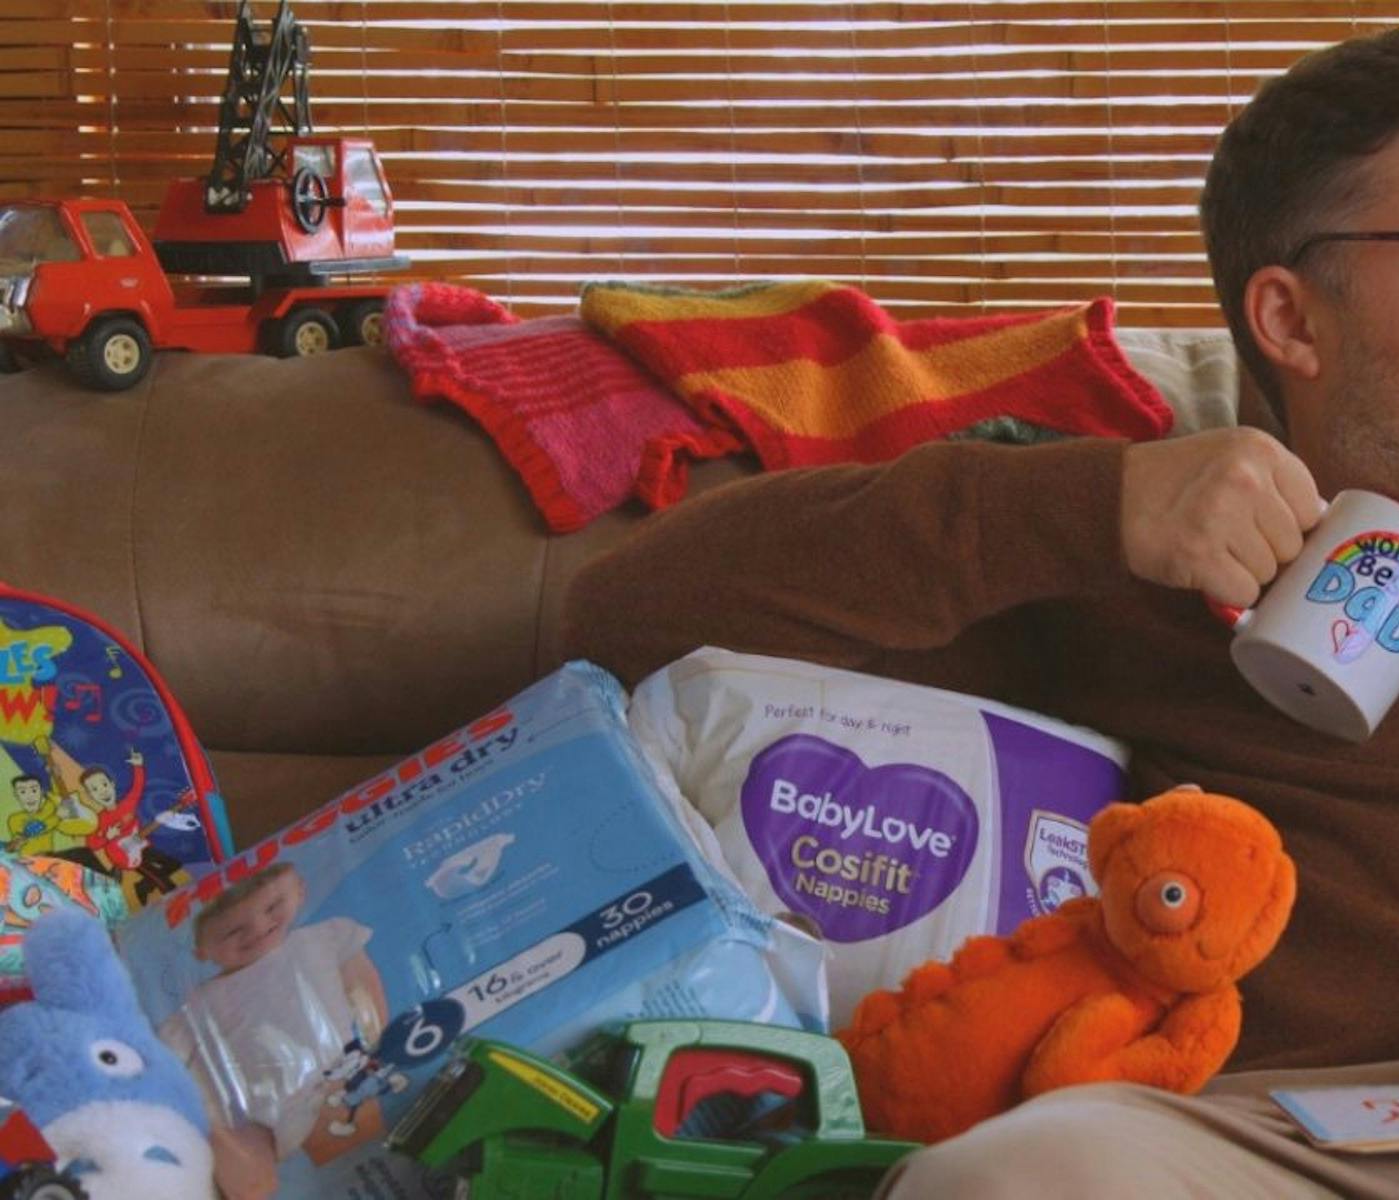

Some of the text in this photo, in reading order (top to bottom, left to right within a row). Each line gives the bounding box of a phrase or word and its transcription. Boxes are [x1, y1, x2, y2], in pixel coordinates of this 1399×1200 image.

[764, 703, 814, 719] Perfect
[819, 708, 836, 722] for
[840, 715, 862, 729] day
[345, 773, 442, 833] ultra
[450, 727, 518, 774] dry
[165, 706, 514, 928] HUGGIES
[402, 771, 546, 861] RapidDry
[770, 778, 952, 858] BabyLove
[791, 835, 913, 895] Cosifit
[600, 891, 652, 930] 30
[795, 873, 891, 915] Nappies
[596, 900, 675, 949] nappies
[468, 975, 507, 1003] 16
[527, 950, 563, 976] over
[405, 1017, 443, 1056] 6
